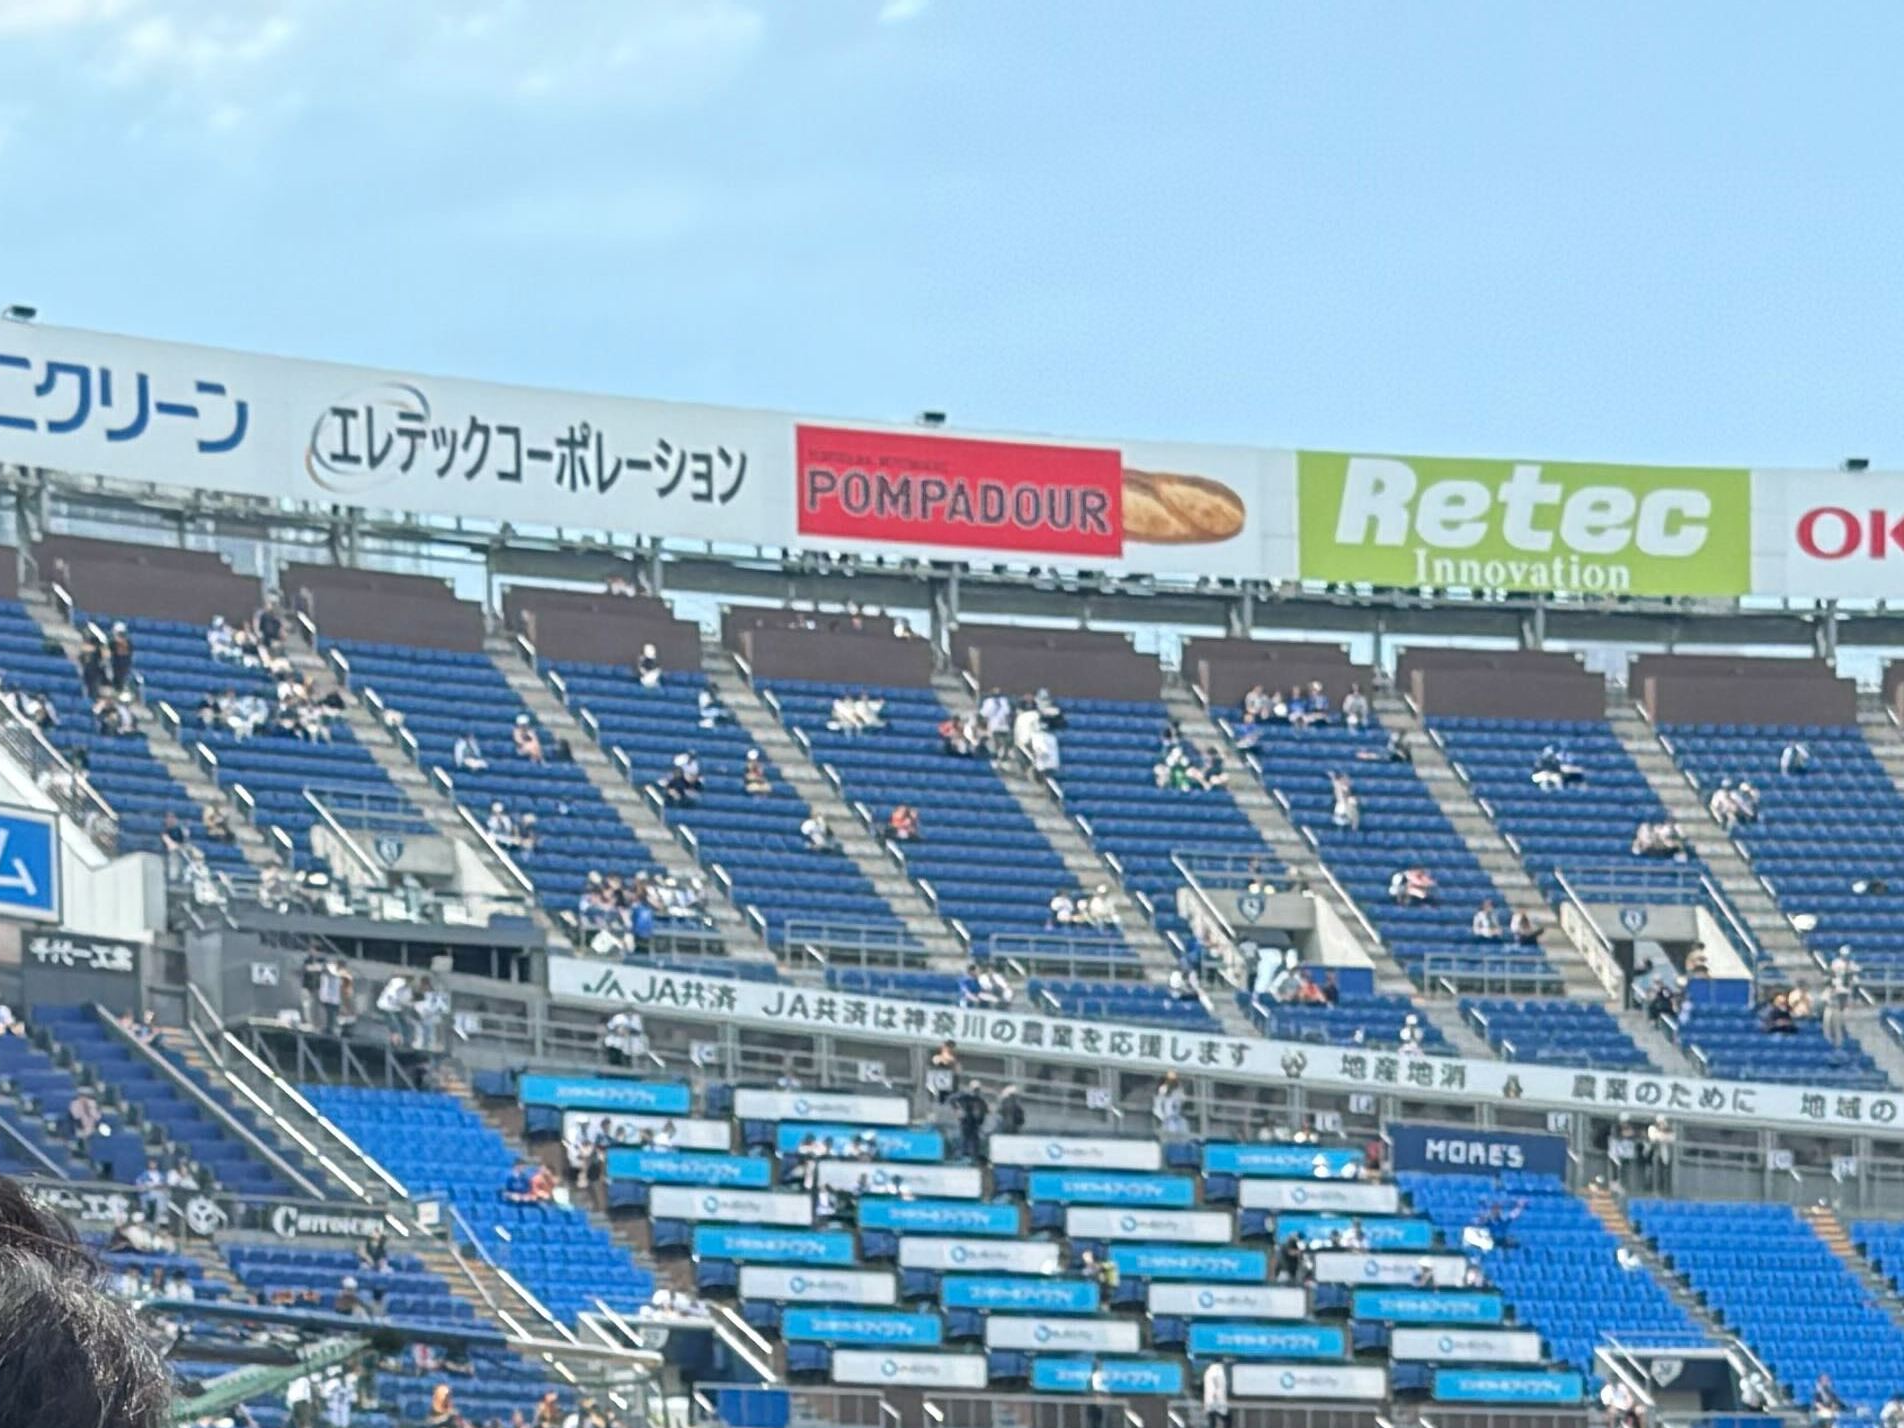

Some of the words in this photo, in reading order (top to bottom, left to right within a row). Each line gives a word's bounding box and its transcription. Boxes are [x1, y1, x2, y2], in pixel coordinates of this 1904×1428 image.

[327, 404, 749, 507] エレデックコーポレーション
[806, 466, 1112, 535] POMPADOUR
[1334, 457, 1713, 557] Retec
[1414, 547, 1631, 592] Innovation
